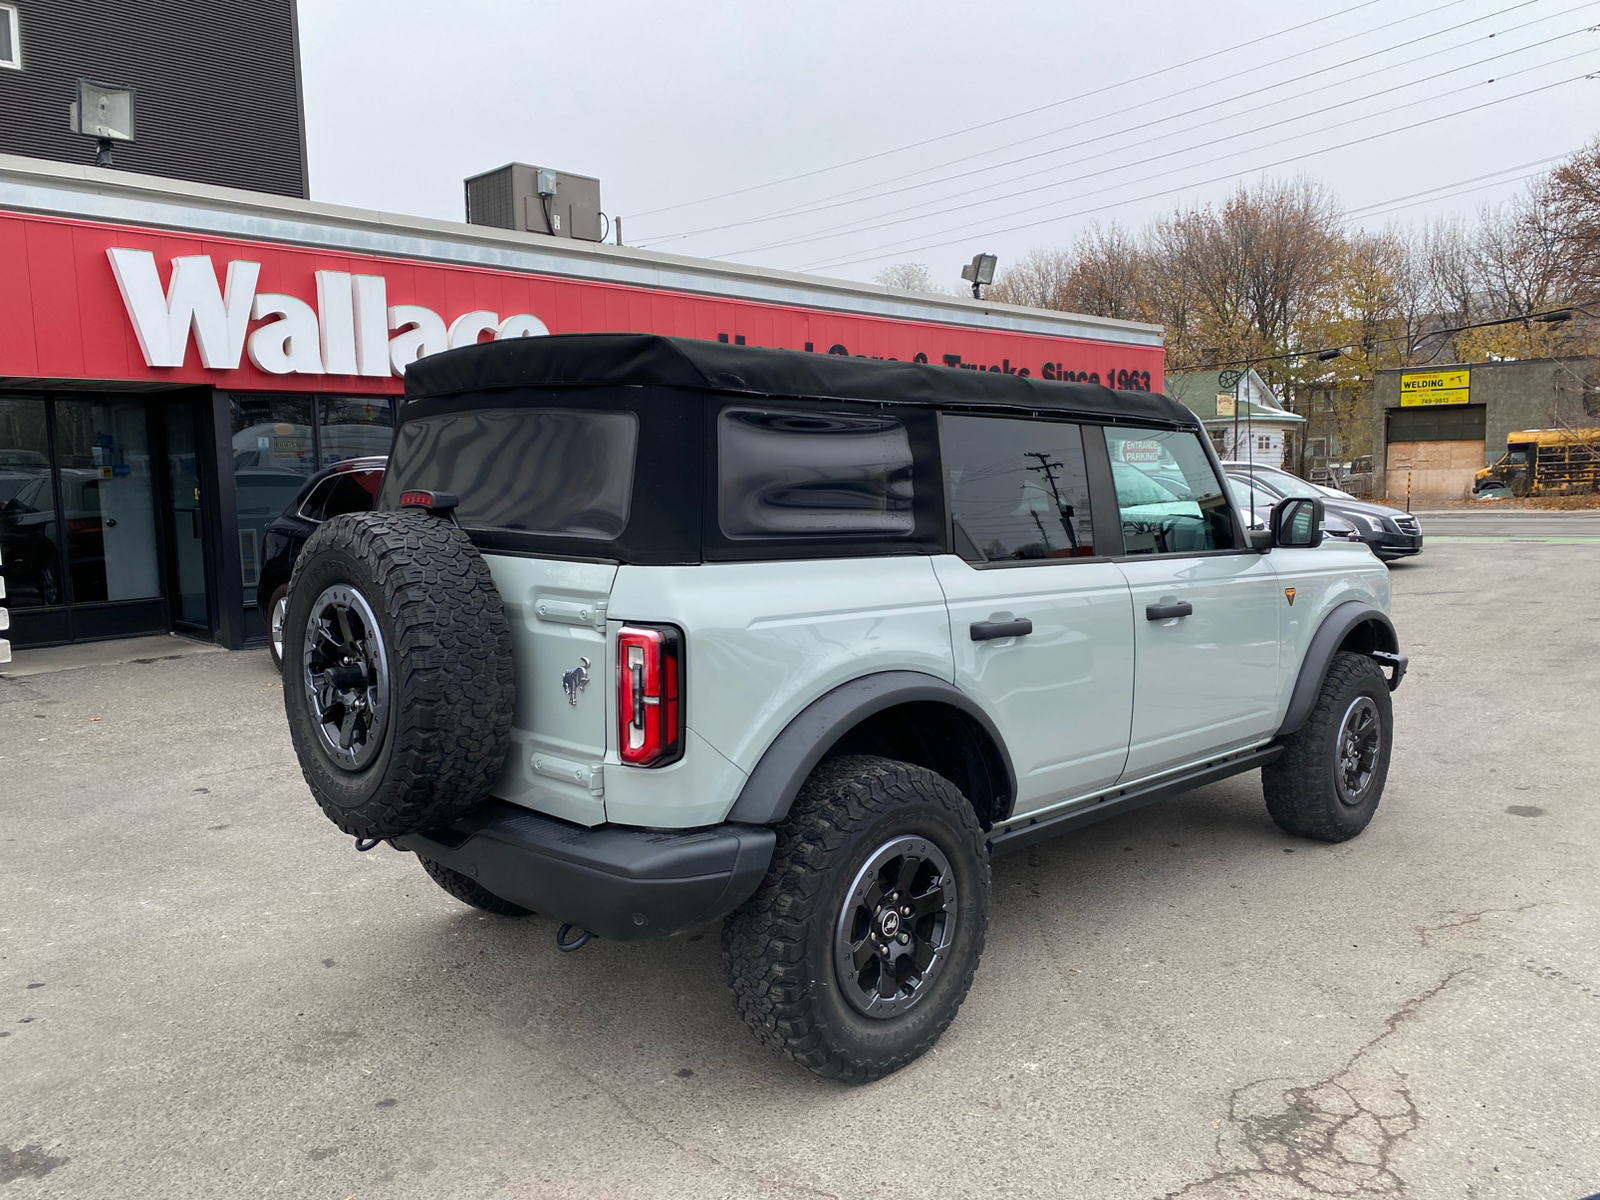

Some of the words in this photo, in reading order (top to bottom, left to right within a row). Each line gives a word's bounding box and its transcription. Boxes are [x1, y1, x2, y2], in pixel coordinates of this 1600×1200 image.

[1107, 369, 1150, 392] 1963
[1403, 379, 1443, 389] WELDING
[1126, 441, 1158, 450] ENTRANCE
[1126, 452, 1158, 461] PARKING
